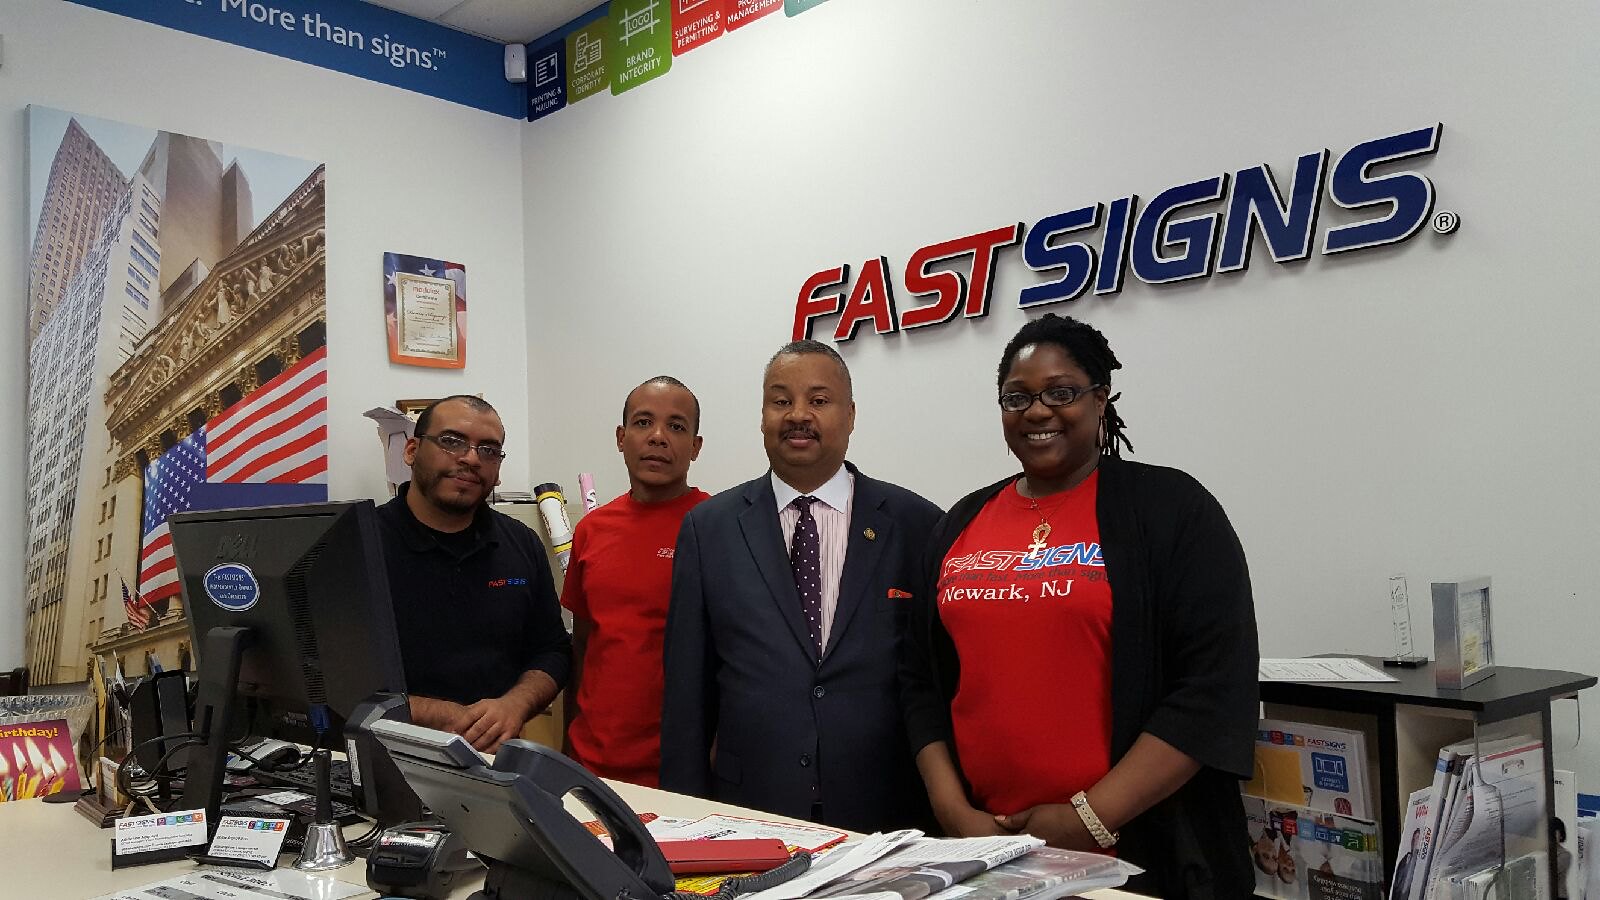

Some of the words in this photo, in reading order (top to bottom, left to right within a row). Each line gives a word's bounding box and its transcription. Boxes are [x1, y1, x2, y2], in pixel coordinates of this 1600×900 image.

[221, 0, 296, 31] More
[302, 13, 364, 50] than
[628, 12, 650, 31] LOGO
[675, 14, 714, 39] SURVEYING
[715, 10, 721, 19] &
[677, 22, 719, 48] PERMITTING
[620, 55, 662, 84] INTEGRITY
[626, 47, 655, 68] BRAND
[941, 583, 1030, 605] Newark,
[1039, 579, 1075, 598] NJ
[0, 727, 59, 739] irthday!
